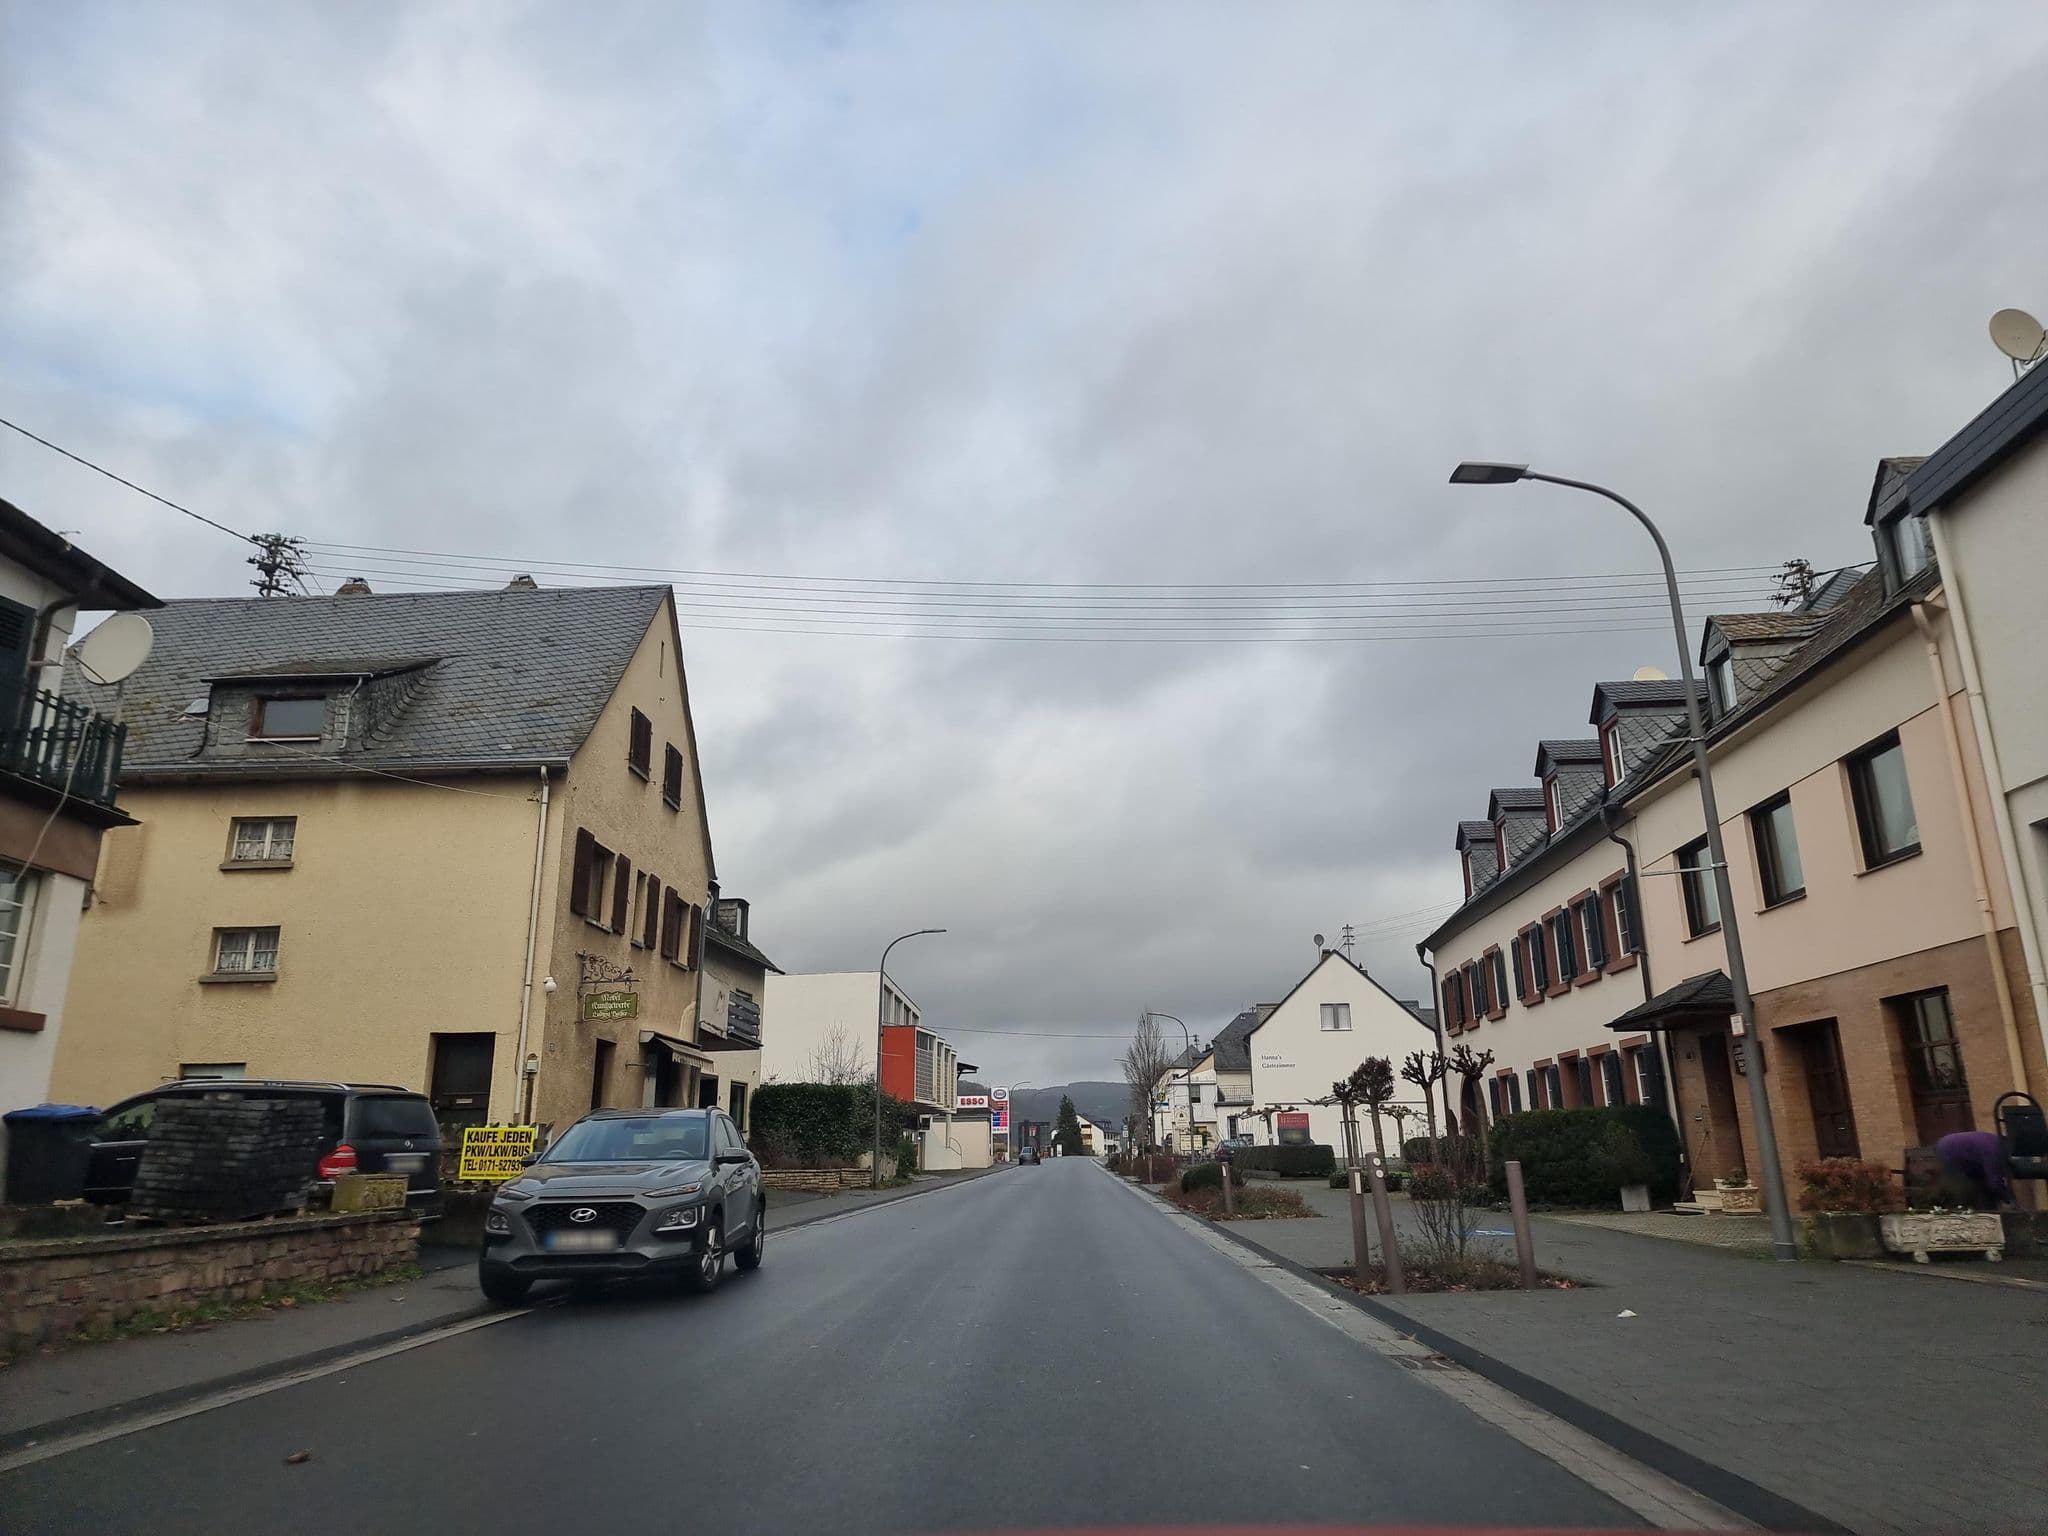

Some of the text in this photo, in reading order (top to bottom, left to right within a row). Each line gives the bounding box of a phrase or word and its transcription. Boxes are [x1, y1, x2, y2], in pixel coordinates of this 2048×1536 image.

[467, 1131, 532, 1143] KAUFE JEDEN
[465, 1145, 530, 1157] PKW/LKW/BUS
